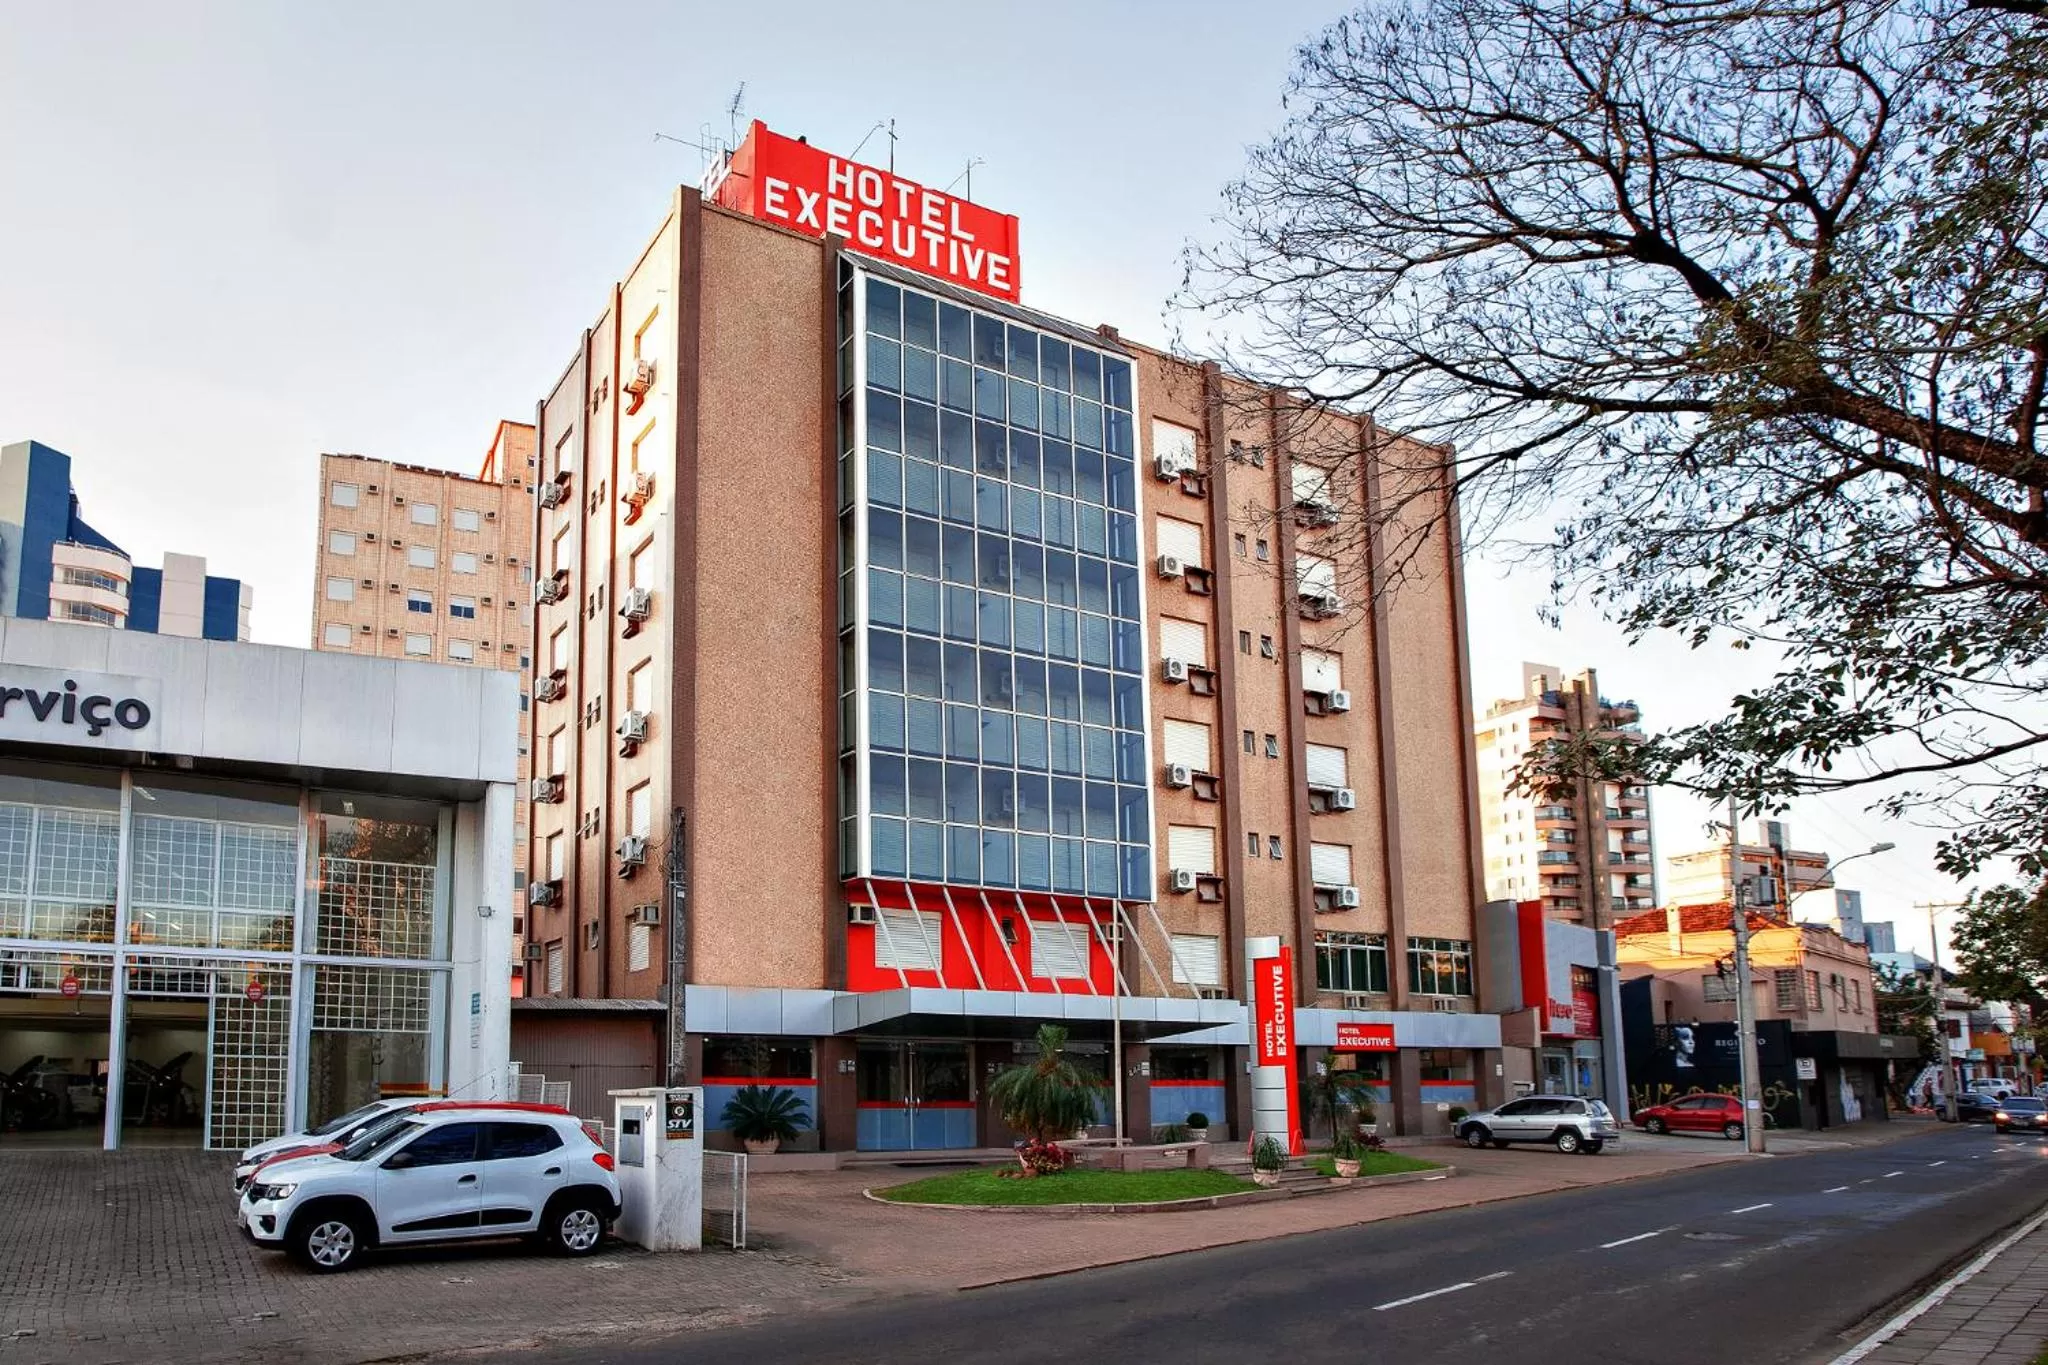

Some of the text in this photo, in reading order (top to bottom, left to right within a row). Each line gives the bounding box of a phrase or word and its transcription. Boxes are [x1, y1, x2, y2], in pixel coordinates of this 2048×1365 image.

[828, 157, 975, 242] HOTEL
[764, 175, 1011, 292] EXECUTIVE
[0, 679, 151, 737] rviço
[1272, 965, 1287, 1057] EXECUTIVE
[1265, 1019, 1274, 1058] HOTEL
[1339, 1037, 1391, 1047] EXECUTIVE
[1714, 1038, 1766, 1047] REGIO
[667, 1119, 692, 1129] STV
